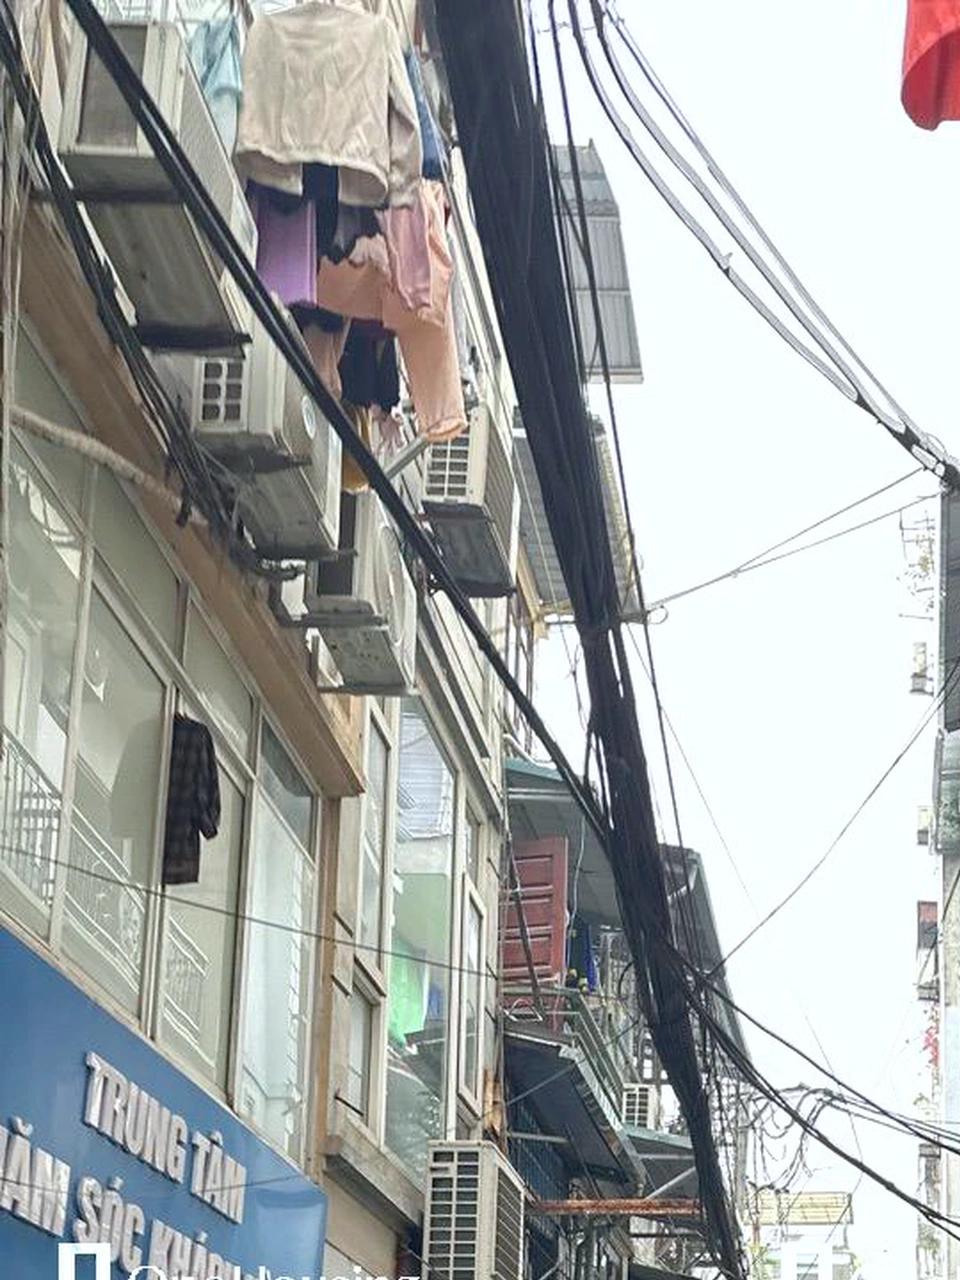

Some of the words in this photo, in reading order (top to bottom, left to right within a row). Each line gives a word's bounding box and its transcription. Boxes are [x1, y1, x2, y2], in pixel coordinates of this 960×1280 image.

[83, 1052, 188, 1184] TRUNG
[190, 1130, 247, 1225] TÂM
[72, 1176, 146, 1274] SÓC
